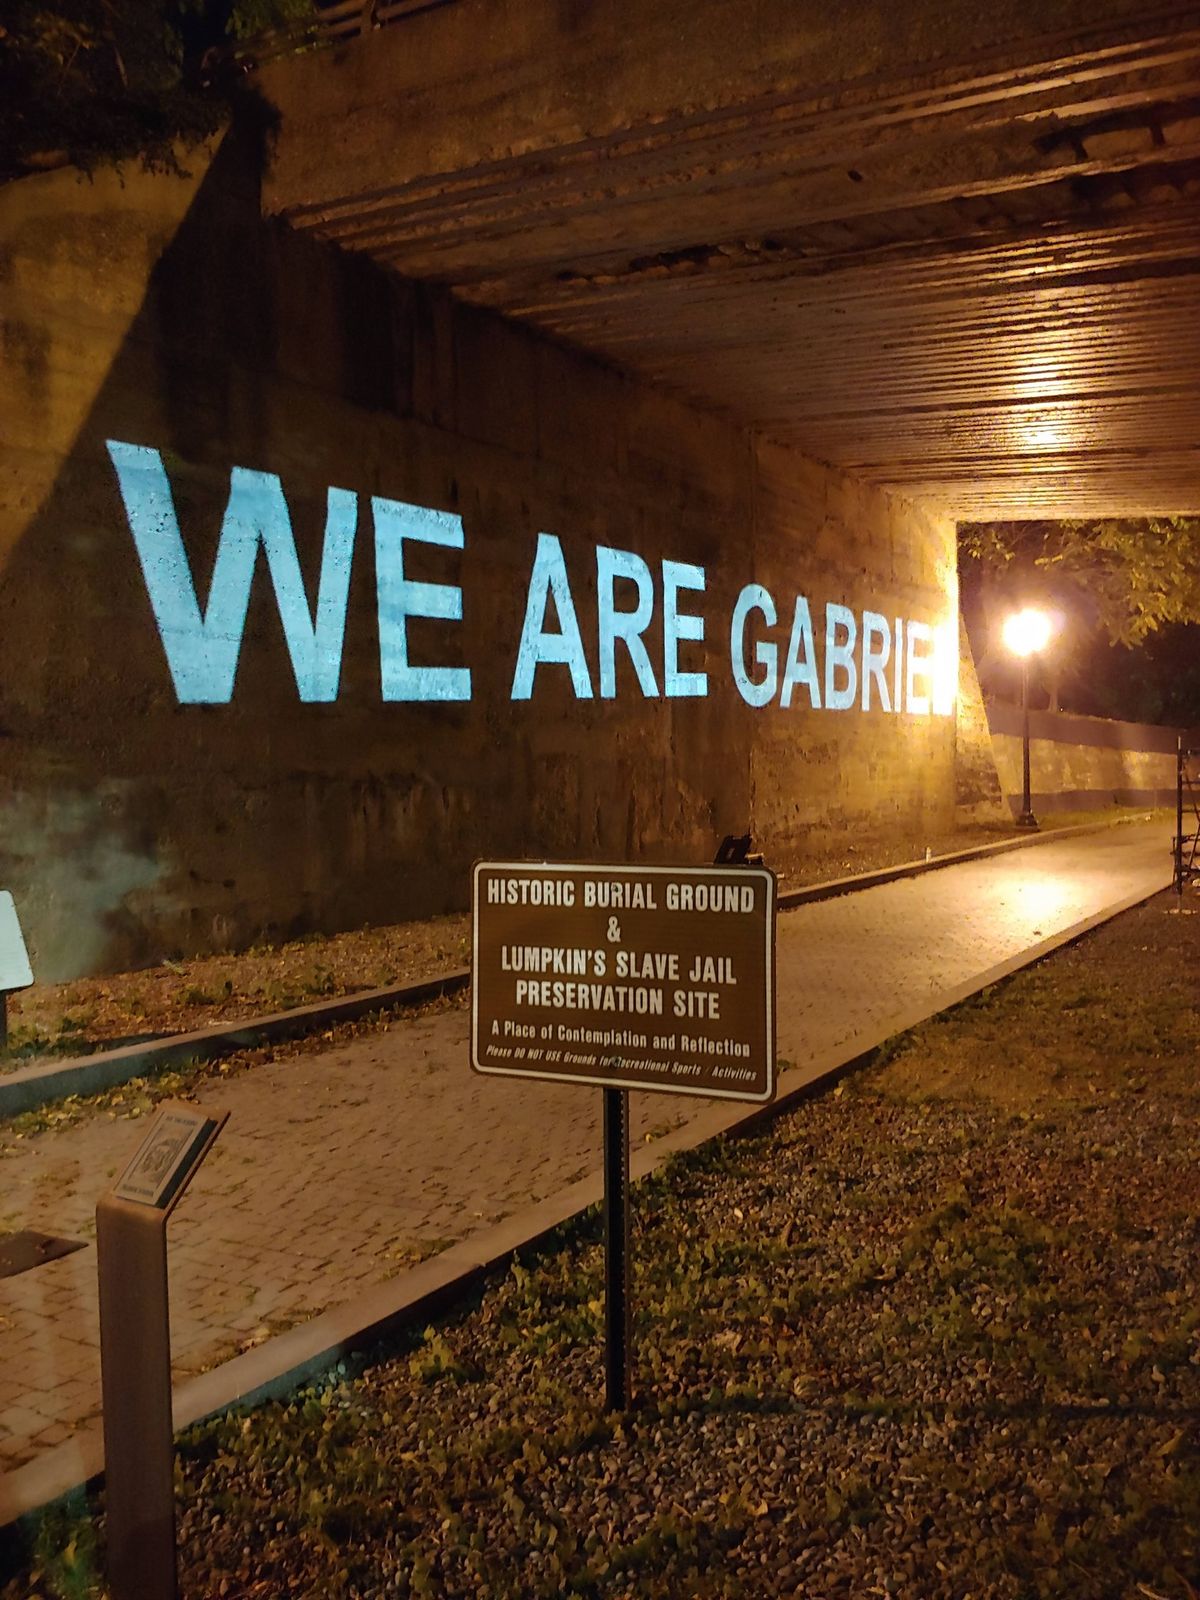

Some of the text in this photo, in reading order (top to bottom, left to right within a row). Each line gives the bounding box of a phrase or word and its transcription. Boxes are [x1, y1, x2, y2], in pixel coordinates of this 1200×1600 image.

[104, 438, 472, 705] WE
[510, 532, 709, 701] ARE
[487, 878, 755, 913] HISTORIC BURIAL GROUND
[606, 916, 622, 943] &
[501, 945, 737, 985] LUMPKIN'S SLAVE JAIL
[516, 979, 720, 1020] PRESERVATION SITE
[491, 1019, 750, 1058] A Place of Contemplation and Reflection
[486, 1044, 512, 1058] Please
[514, 1047, 526, 1059] DO
[527, 1048, 544, 1060] NOT
[545, 1050, 562, 1063] USE
[563, 1051, 597, 1066] Grounds
[671, 1061, 702, 1076] Sports
[712, 1065, 757, 1081] Activities
